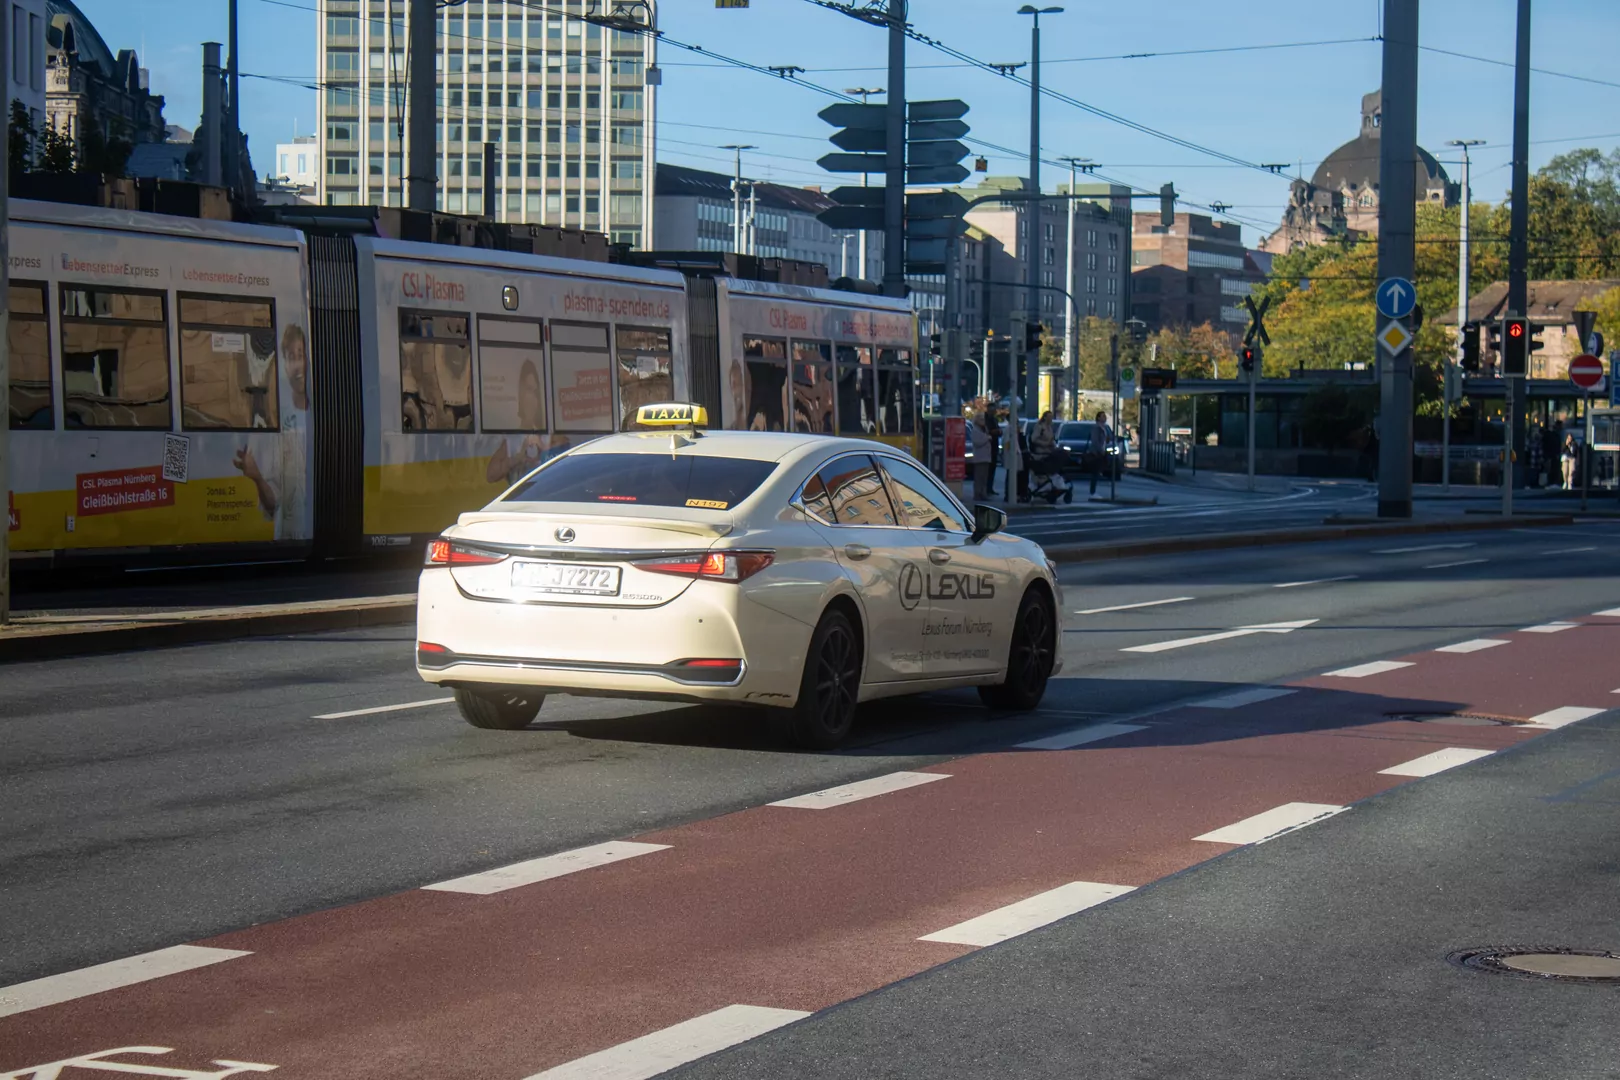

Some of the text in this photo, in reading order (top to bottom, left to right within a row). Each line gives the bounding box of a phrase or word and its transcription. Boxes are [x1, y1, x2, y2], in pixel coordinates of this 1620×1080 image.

[182, 268, 270, 287] LebensretterExpress
[402, 272, 465, 301] CSL Plasma
[564, 291, 670, 319] plasma-spenden.de
[650, 407, 688, 419] TAXI
[82, 473, 156, 489] CSL Plasma Nürnberg
[83, 488, 167, 509] Gleißbühlstraße 16
[926, 573, 995, 599] LEXUS
